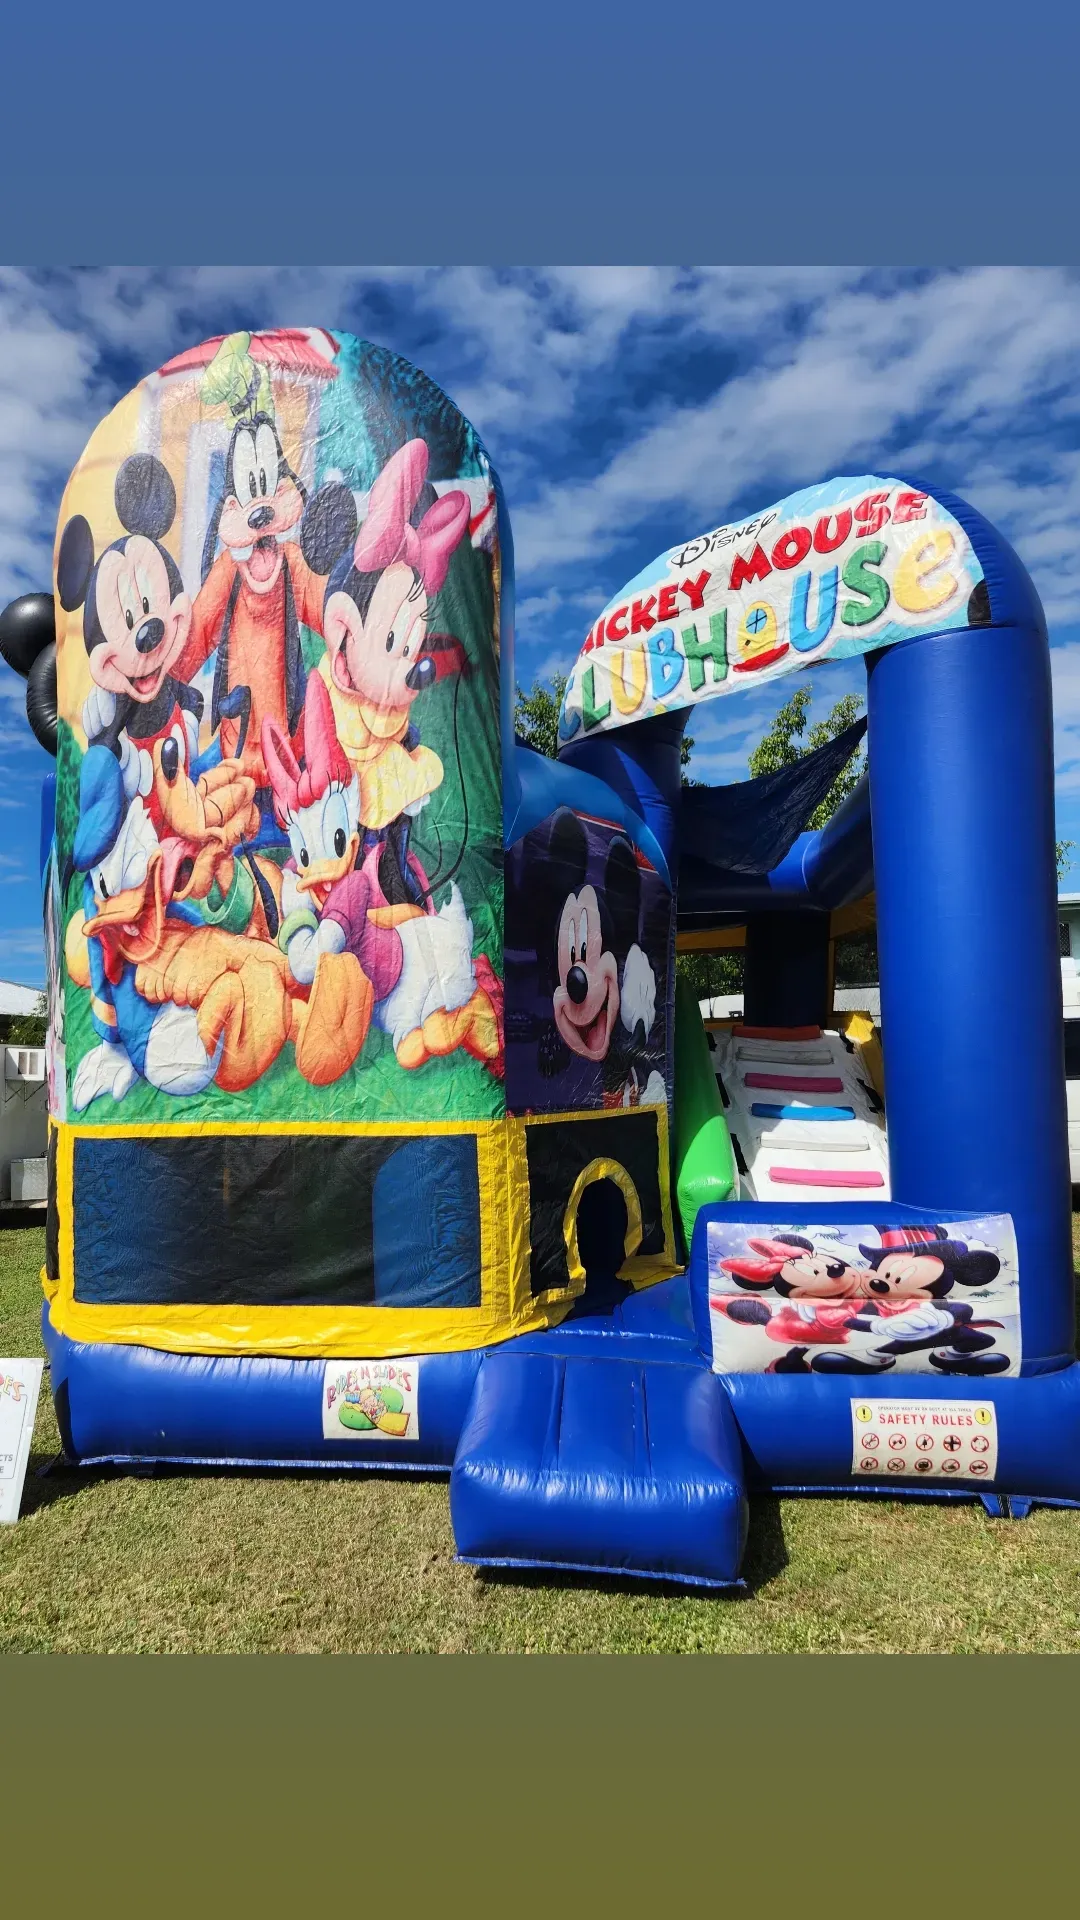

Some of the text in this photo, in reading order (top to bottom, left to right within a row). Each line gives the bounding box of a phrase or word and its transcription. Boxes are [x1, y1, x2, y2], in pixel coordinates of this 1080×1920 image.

[726, 491, 930, 591] MOUSE
[326, 1364, 412, 1410] RIDES N SLIDES
[879, 1413, 974, 1427] SAFETY RULES
